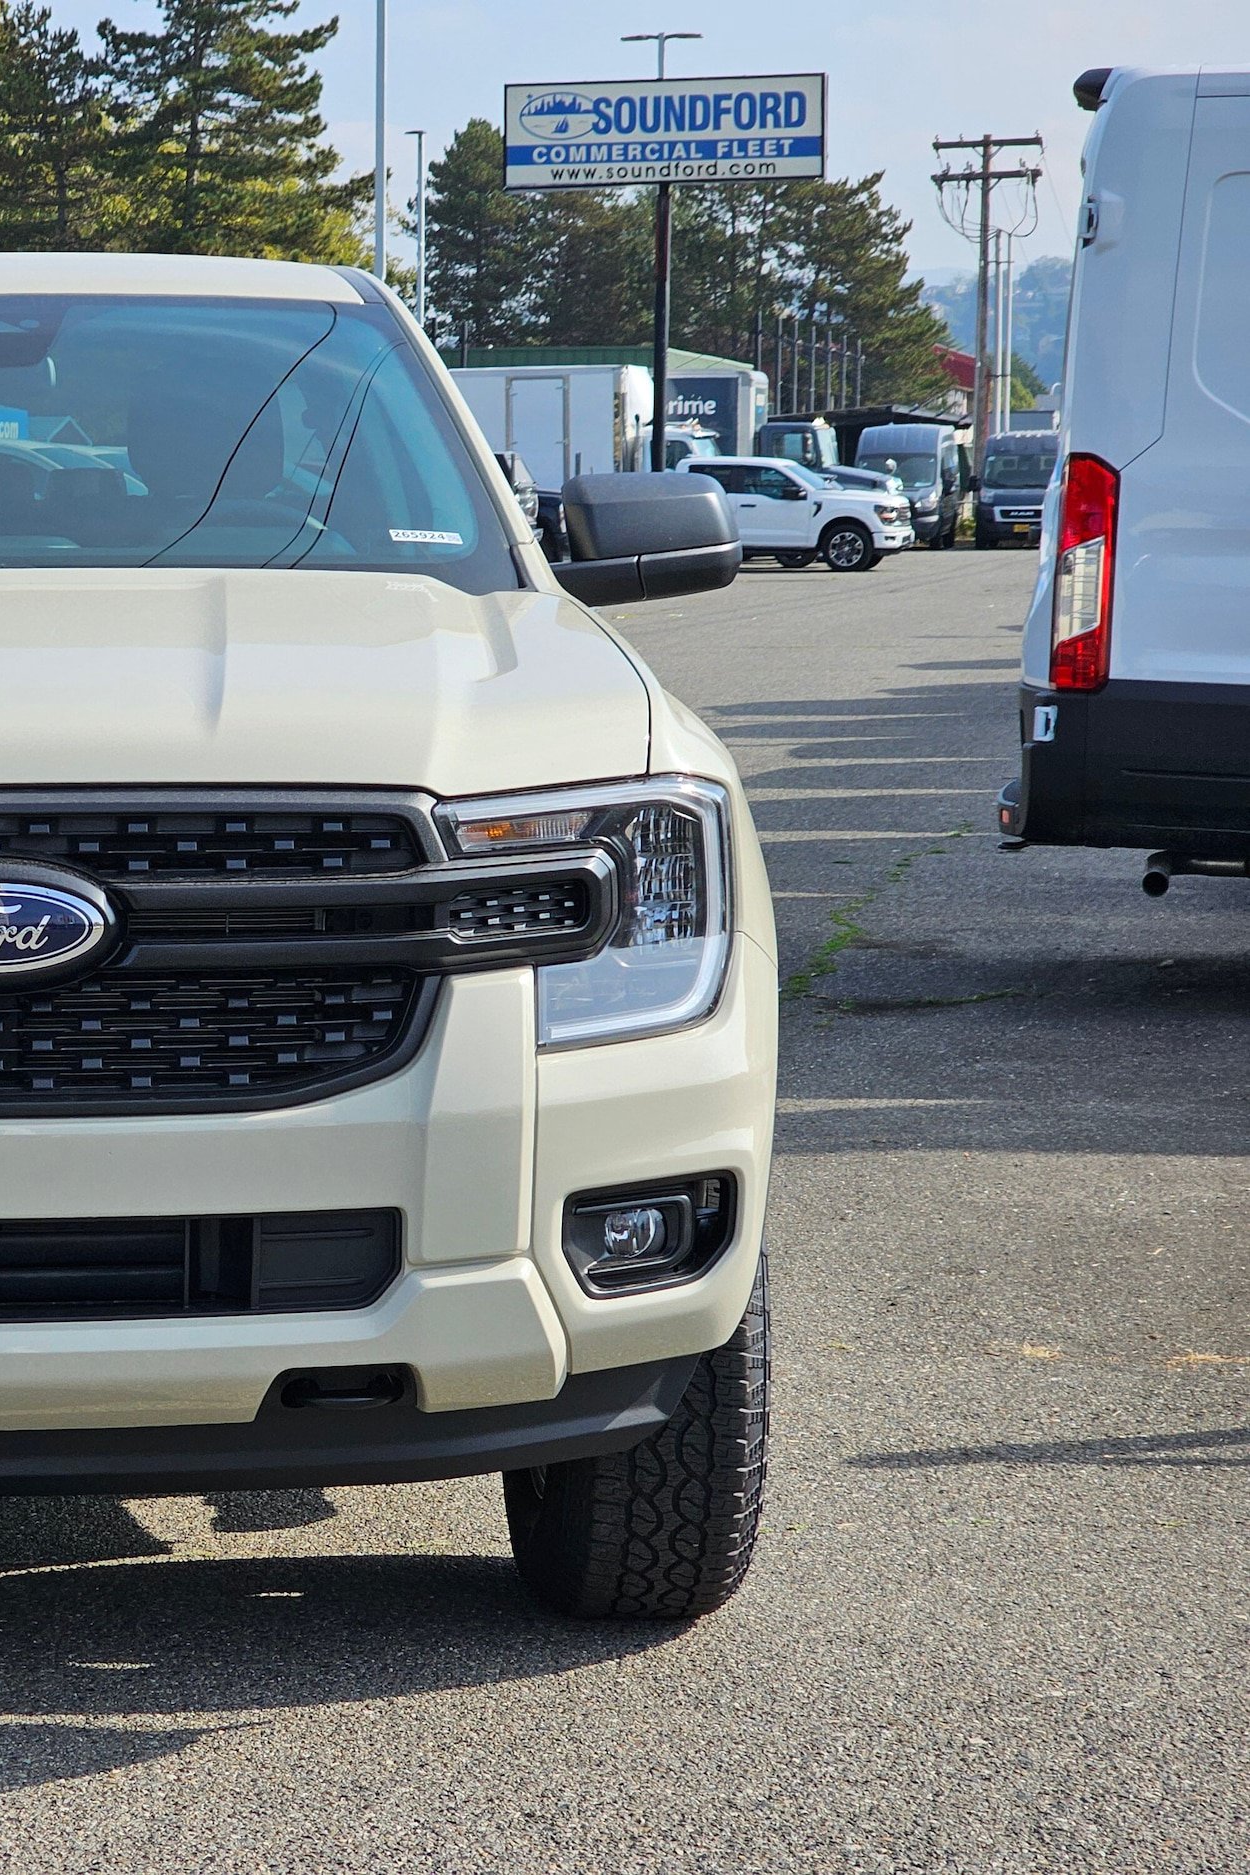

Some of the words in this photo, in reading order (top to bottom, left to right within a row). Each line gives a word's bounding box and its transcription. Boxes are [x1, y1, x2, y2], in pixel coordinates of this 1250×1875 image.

[592, 91, 807, 135] SOUNDFORD
[532, 140, 703, 164] COMMERCIAL
[717, 139, 794, 158] FLEET
[551, 161, 776, 181] www.soundford.com
[665, 395, 717, 415] rime
[392, 530, 446, 540] 265924
